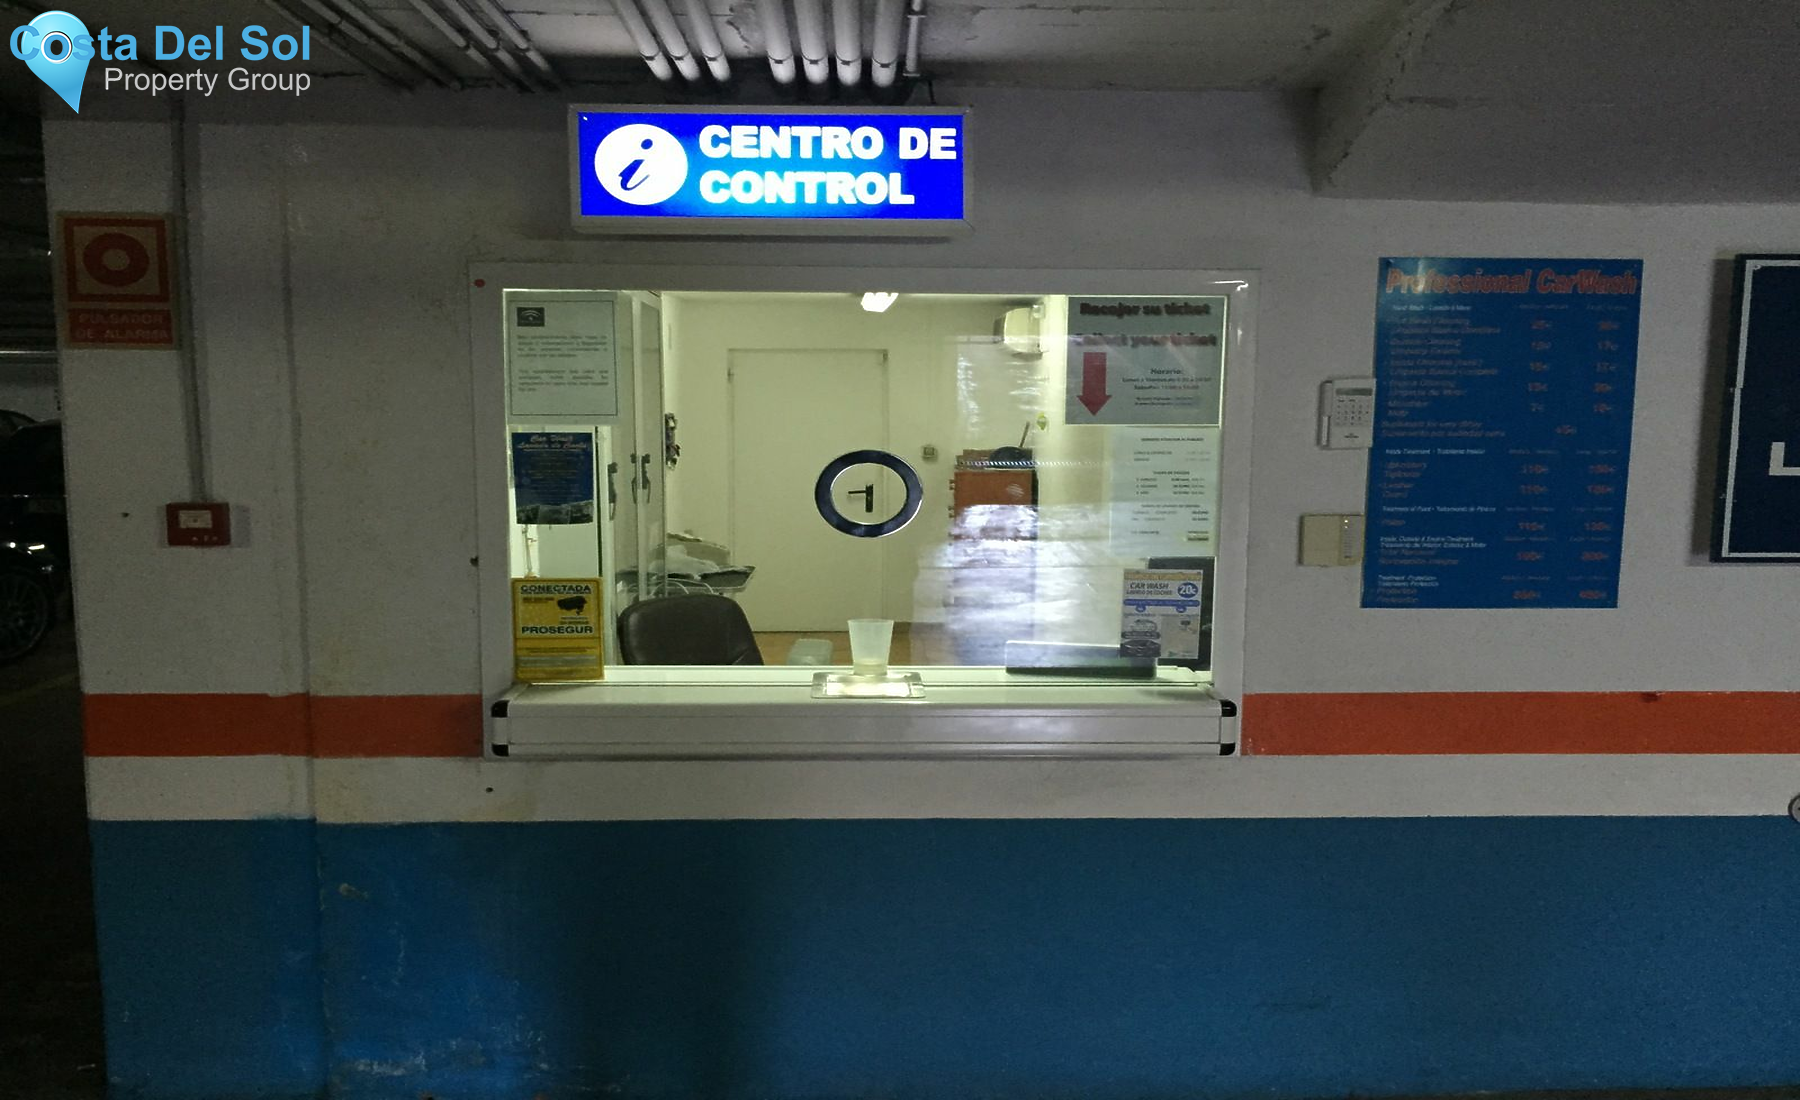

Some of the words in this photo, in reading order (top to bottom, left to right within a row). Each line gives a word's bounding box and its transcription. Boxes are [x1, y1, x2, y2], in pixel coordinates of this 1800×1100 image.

[699, 124, 884, 160] CENTRO
[899, 127, 957, 160] DE
[699, 170, 916, 205] CONTROL
[1386, 268, 1532, 294] Professional
[521, 584, 591, 592] CONECTADA
[1147, 582, 1169, 590] WASH
[521, 626, 593, 634] PROSEGUR
